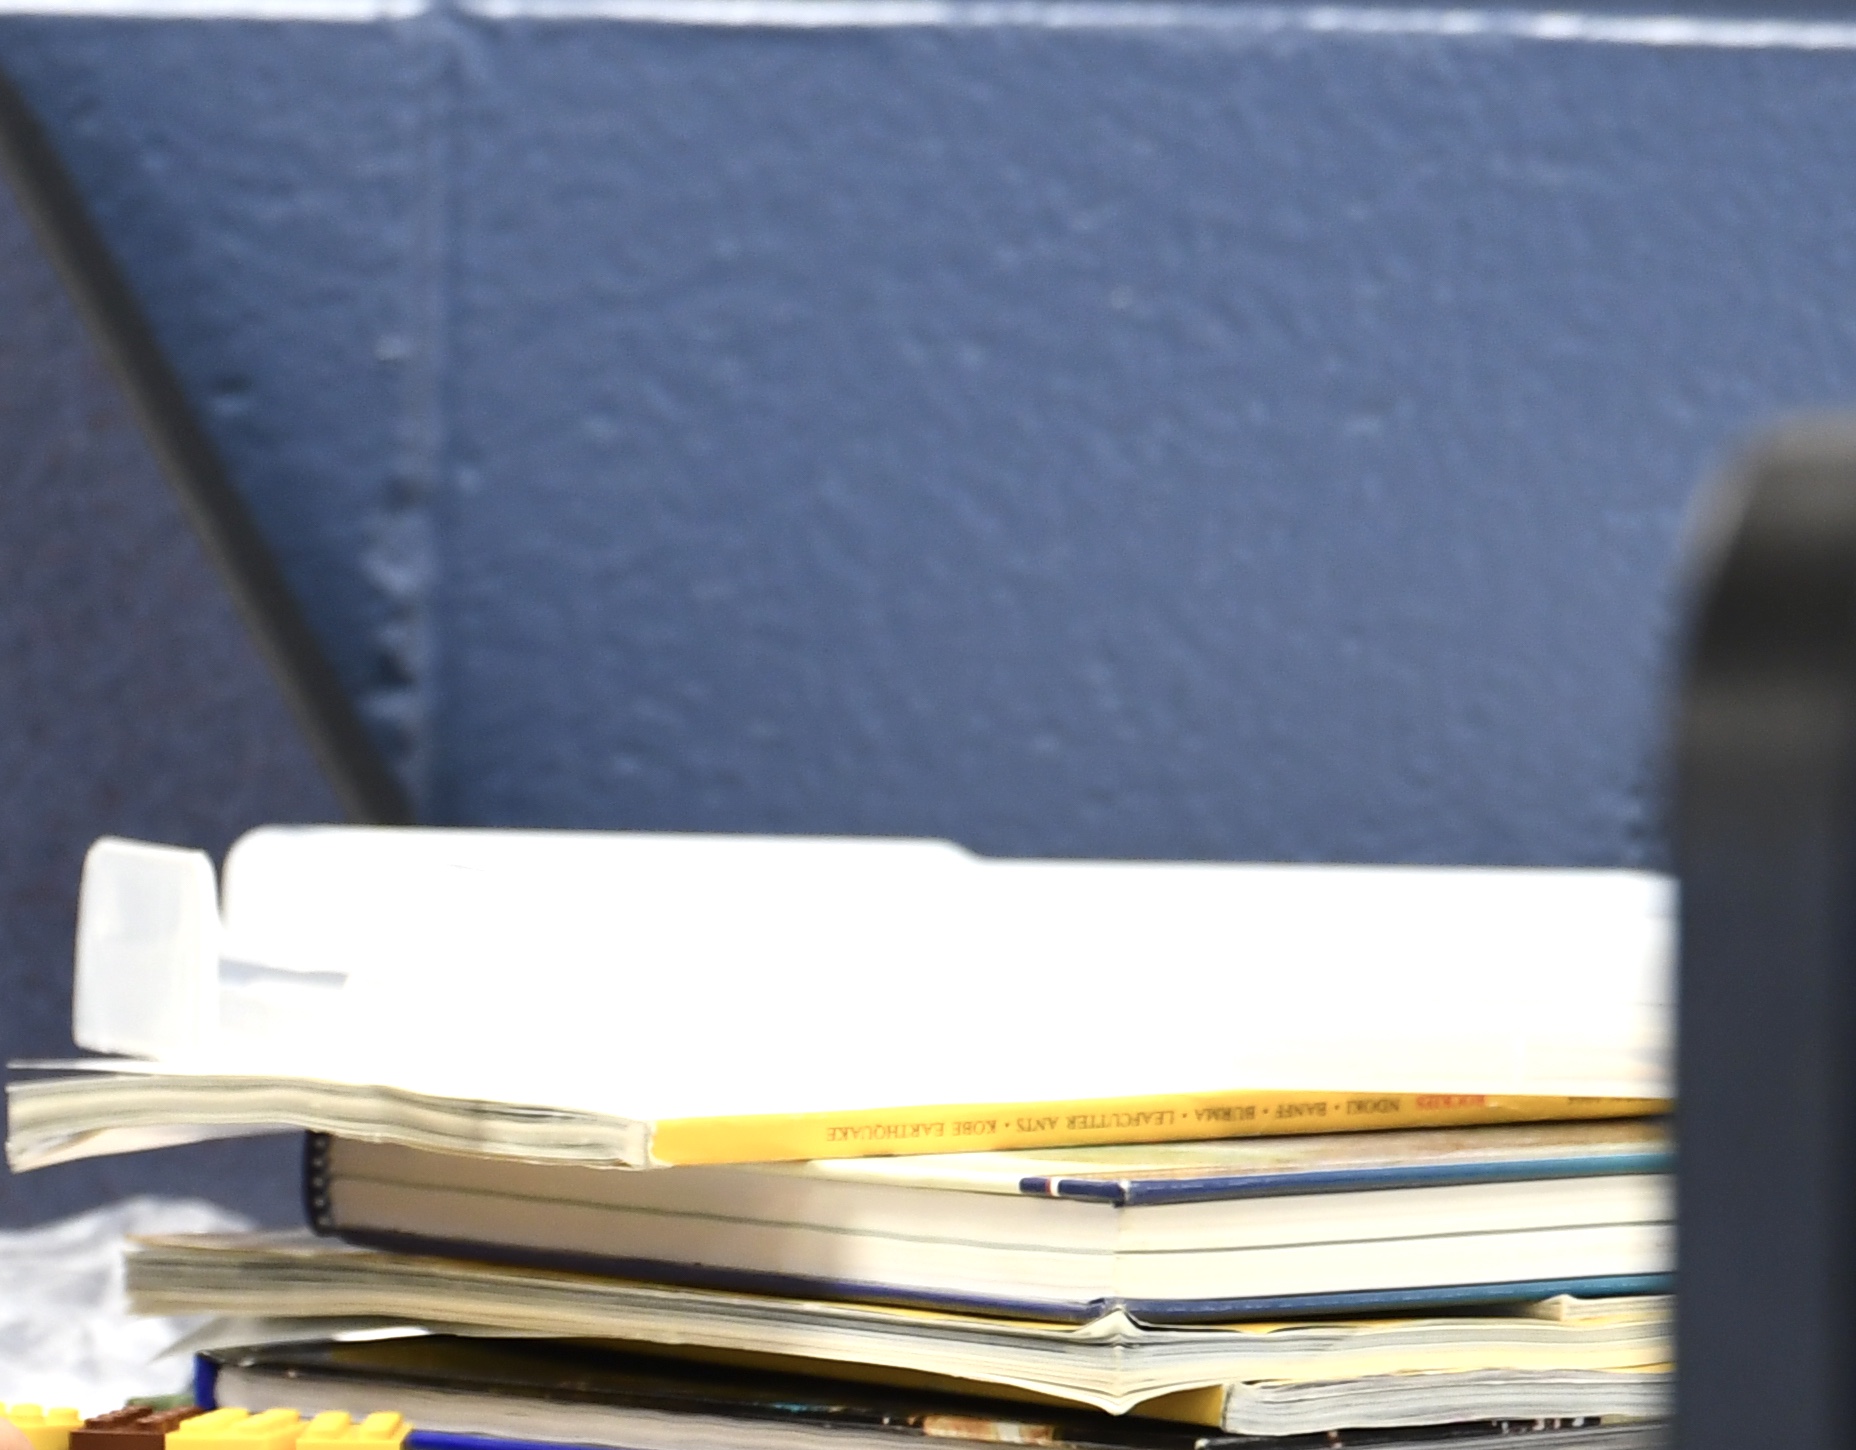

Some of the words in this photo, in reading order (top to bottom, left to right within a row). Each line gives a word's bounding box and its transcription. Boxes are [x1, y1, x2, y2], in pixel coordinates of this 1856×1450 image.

[1195, 1105, 1255, 1122] BURMA
[1275, 1101, 1327, 1118] BANFF
[1346, 1097, 1400, 1113] NDOKI
[952, 1119, 997, 1136] KOBE
[1016, 1116, 1058, 1132] ANTS
[1066, 1110, 1175, 1130] LEAFCUTTER
[826, 1122, 944, 1142] EARTHQUAKE
